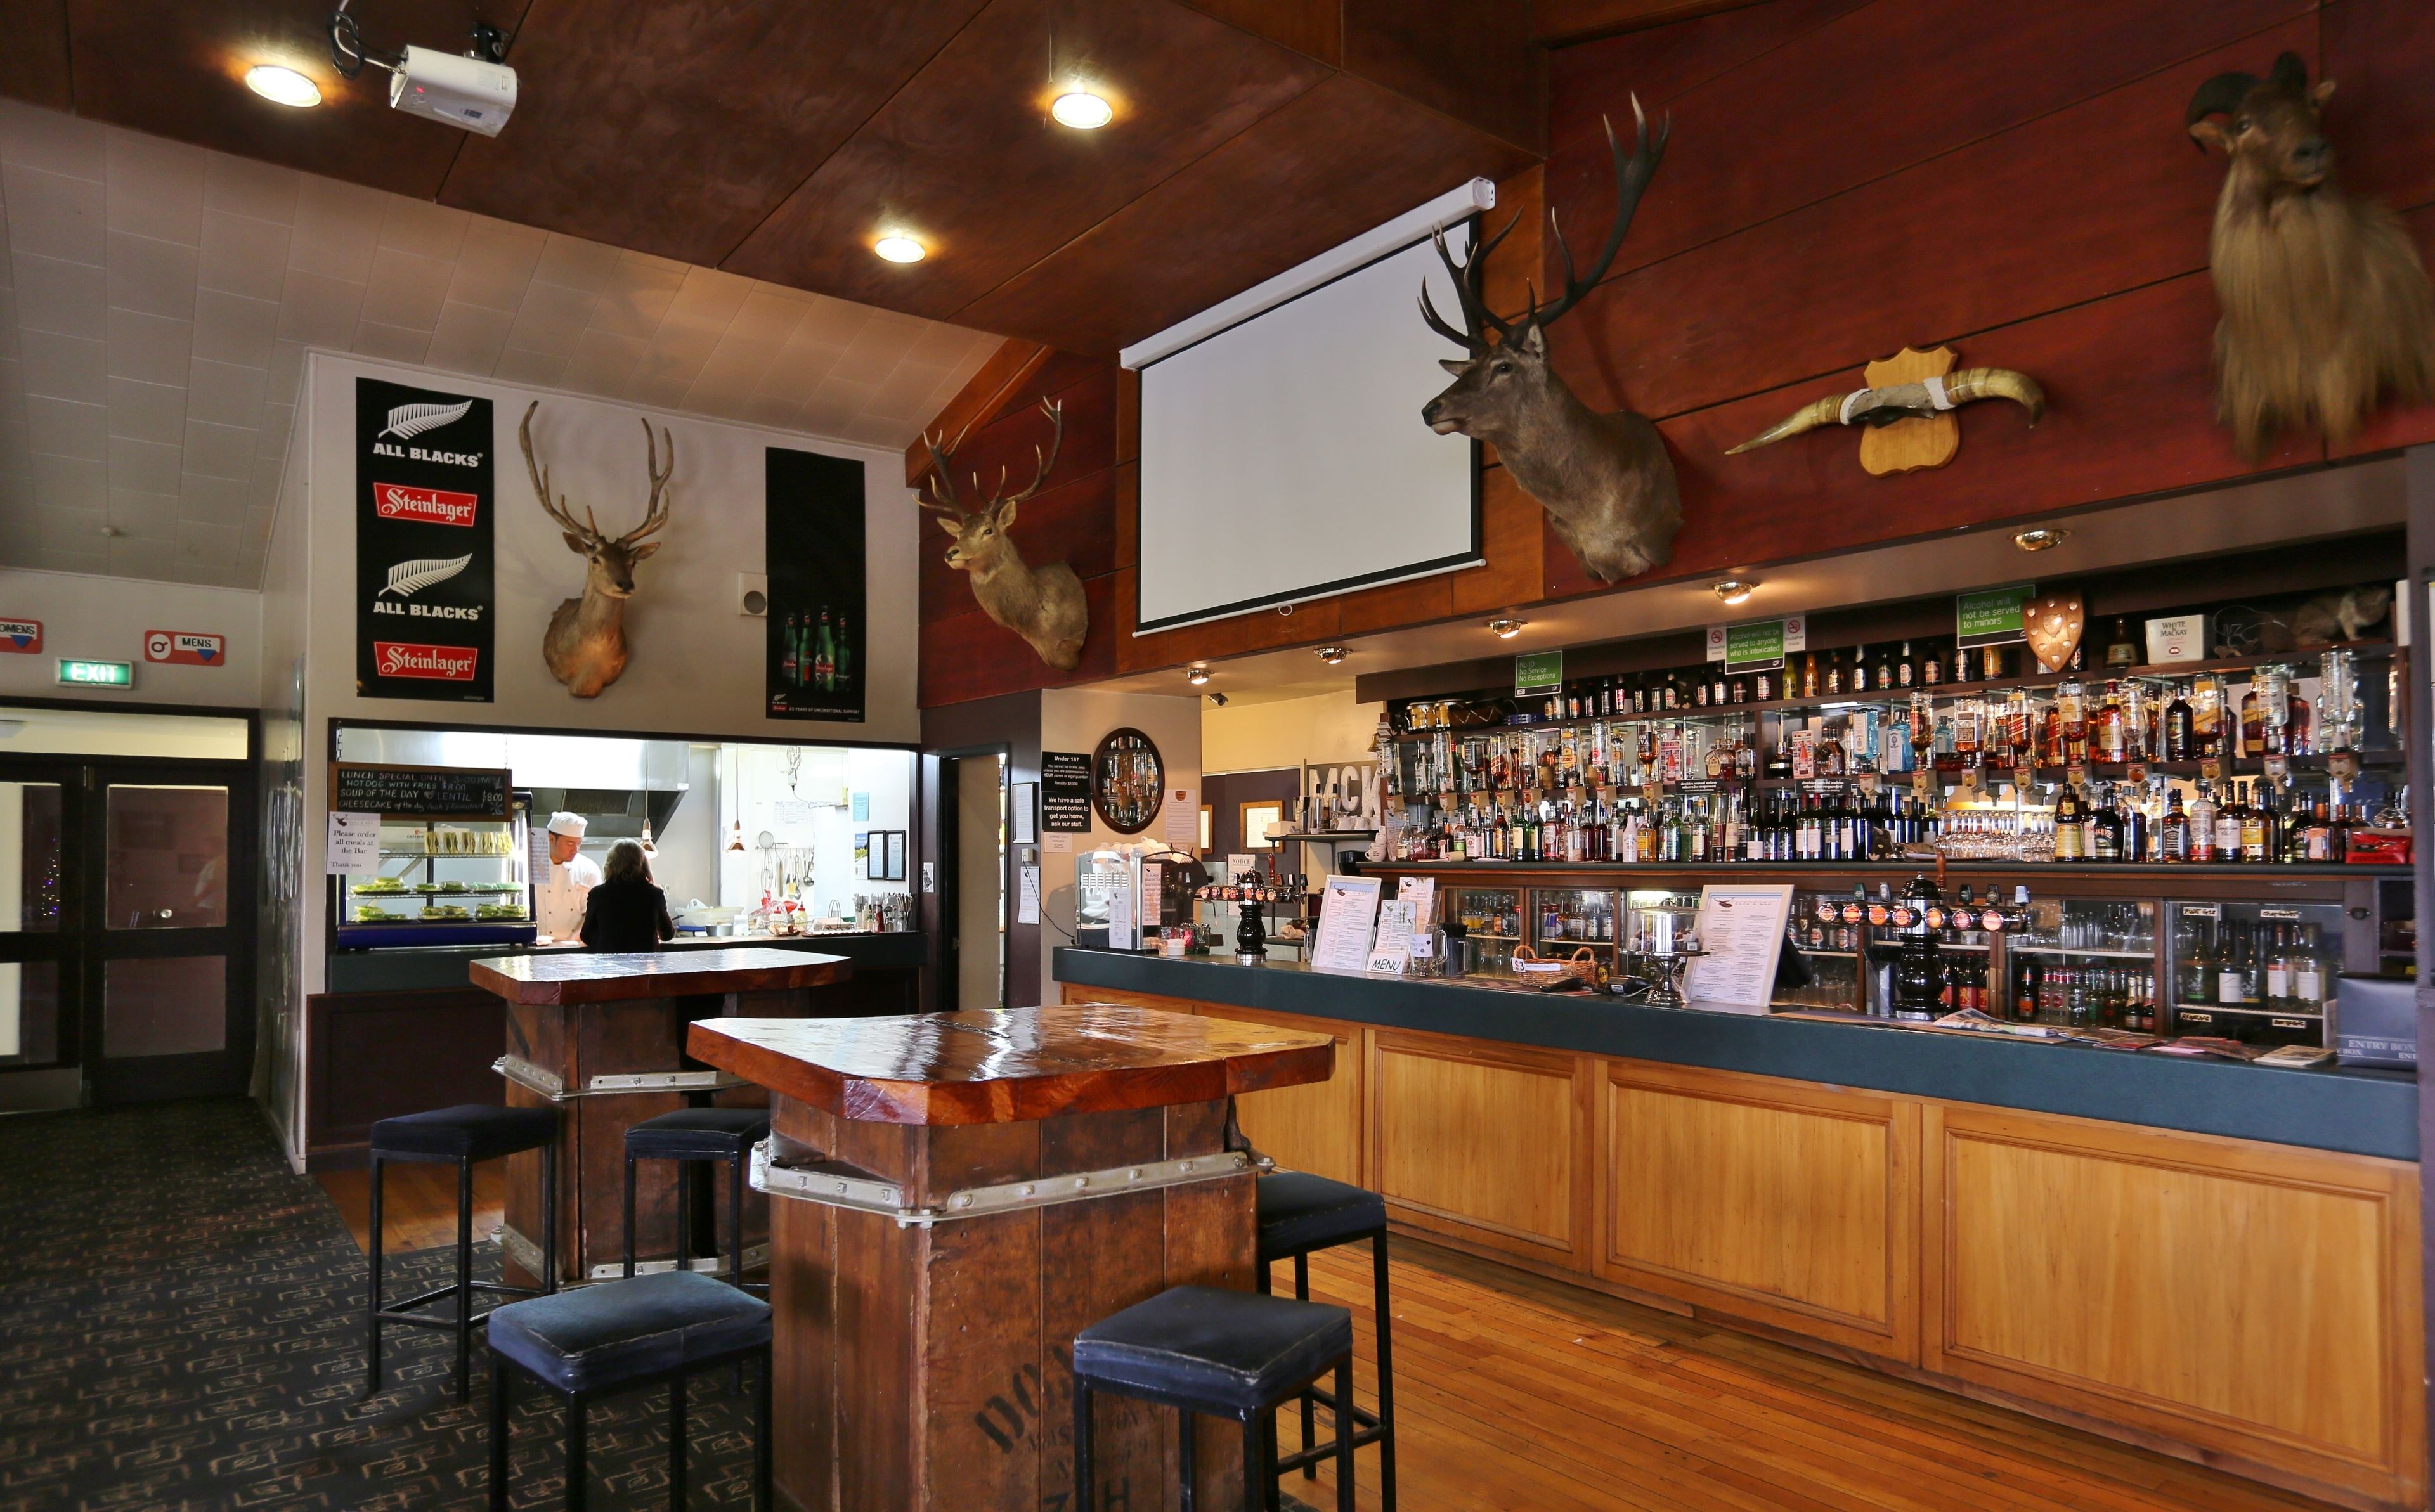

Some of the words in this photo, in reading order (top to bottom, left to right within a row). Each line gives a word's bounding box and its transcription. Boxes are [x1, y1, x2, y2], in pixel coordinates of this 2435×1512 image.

[373, 443, 405, 457] ALL
[410, 448, 478, 467] BLACKS
[381, 488, 471, 522] Steinlager
[1964, 600, 1994, 610] Alcohol
[1996, 597, 2010, 605] will
[373, 602, 405, 614] ALL
[410, 604, 478, 620] BLACKS
[1992, 605, 2020, 616] served
[1975, 618, 2001, 626] minors
[182, 637, 211, 648] MENS
[1757, 638, 1777, 646] anyone
[1750, 645, 1780, 654] intoxicated
[382, 646, 472, 676] Steinlager
[70, 664, 118, 682] EXIT
[437, 792, 471, 801] LENTIL
[414, 803, 425, 811] day
[1372, 959, 1401, 970] MENU
[1514, 960, 1524, 971] $3
[2349, 1040, 2388, 1050] ENTRY
[2391, 1043, 2415, 1051] BOX
